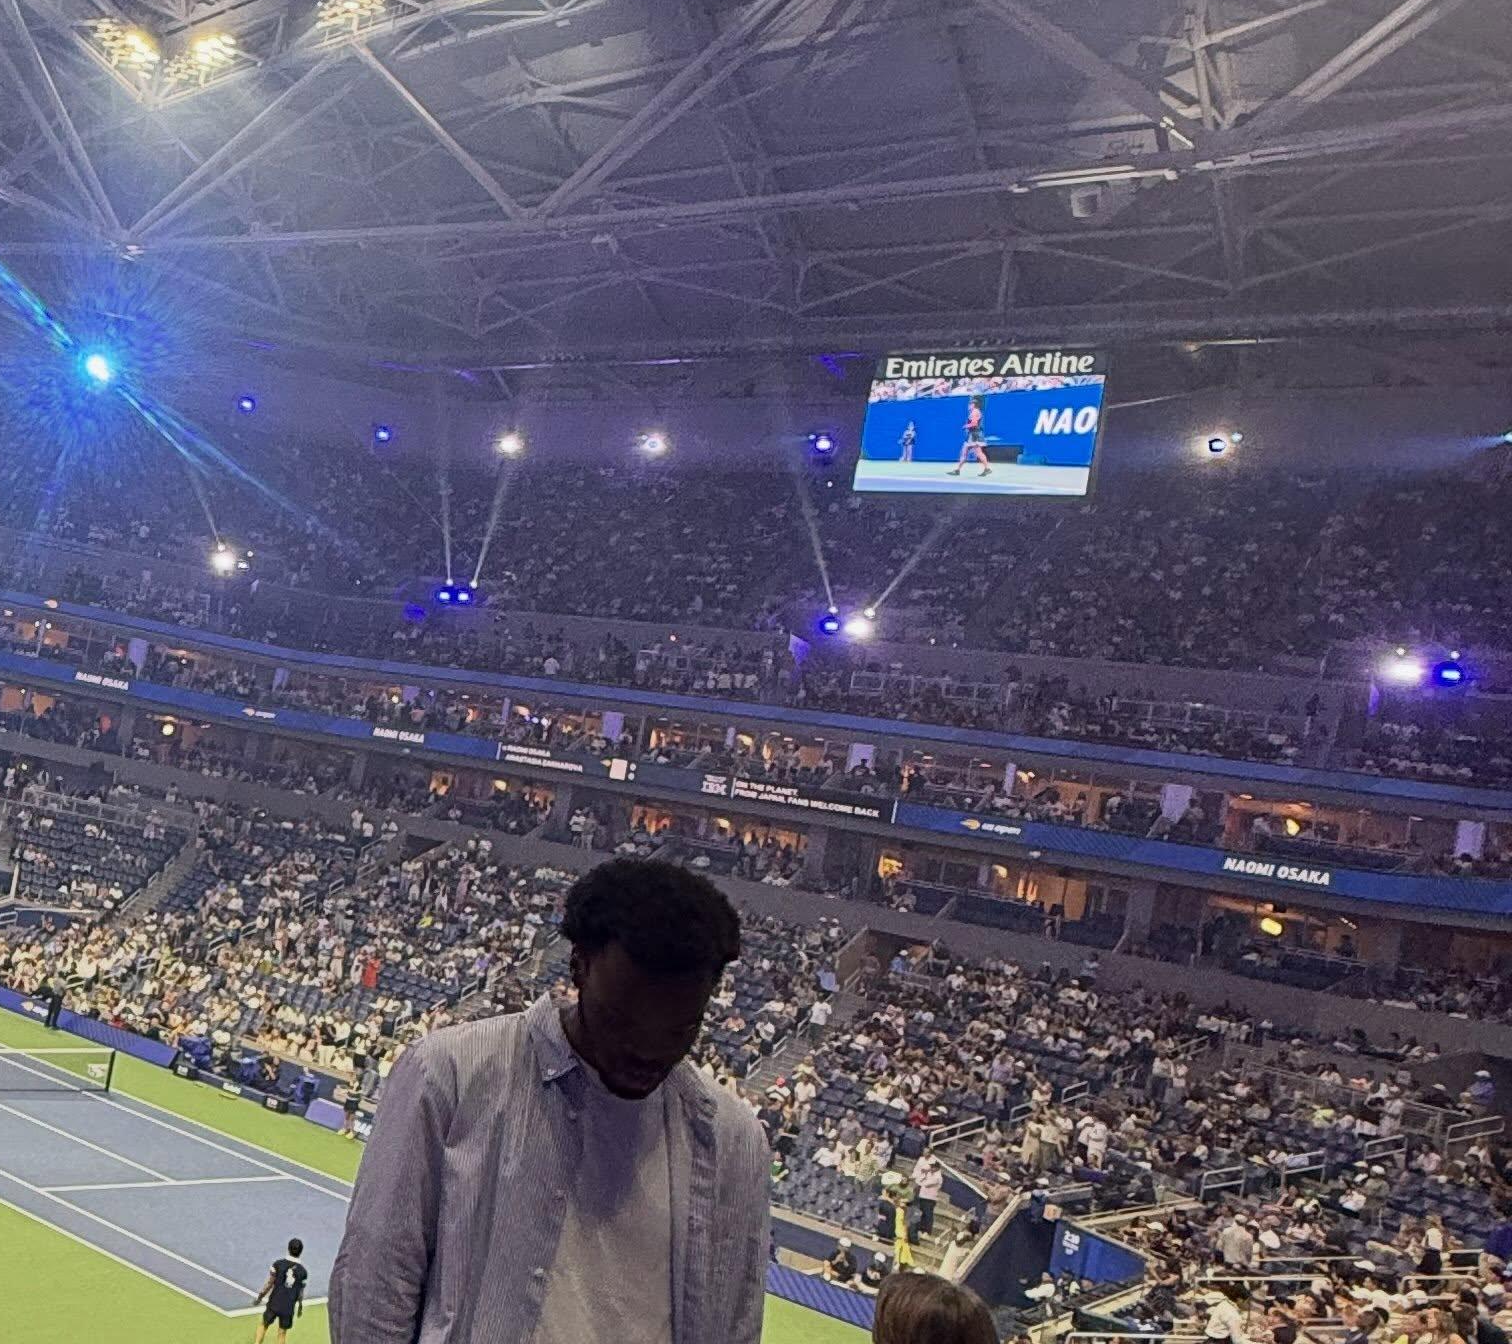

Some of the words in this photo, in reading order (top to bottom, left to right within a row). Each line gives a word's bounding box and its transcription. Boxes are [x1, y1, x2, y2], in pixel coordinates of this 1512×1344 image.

[886, 354, 995, 378] Emirates
[1000, 351, 1095, 375] Airline
[810, 800, 854, 814] WELCOME
[854, 807, 880, 818] BACK
[1223, 857, 1275, 876] NAOMI
[1276, 866, 1330, 885] OSAKA
